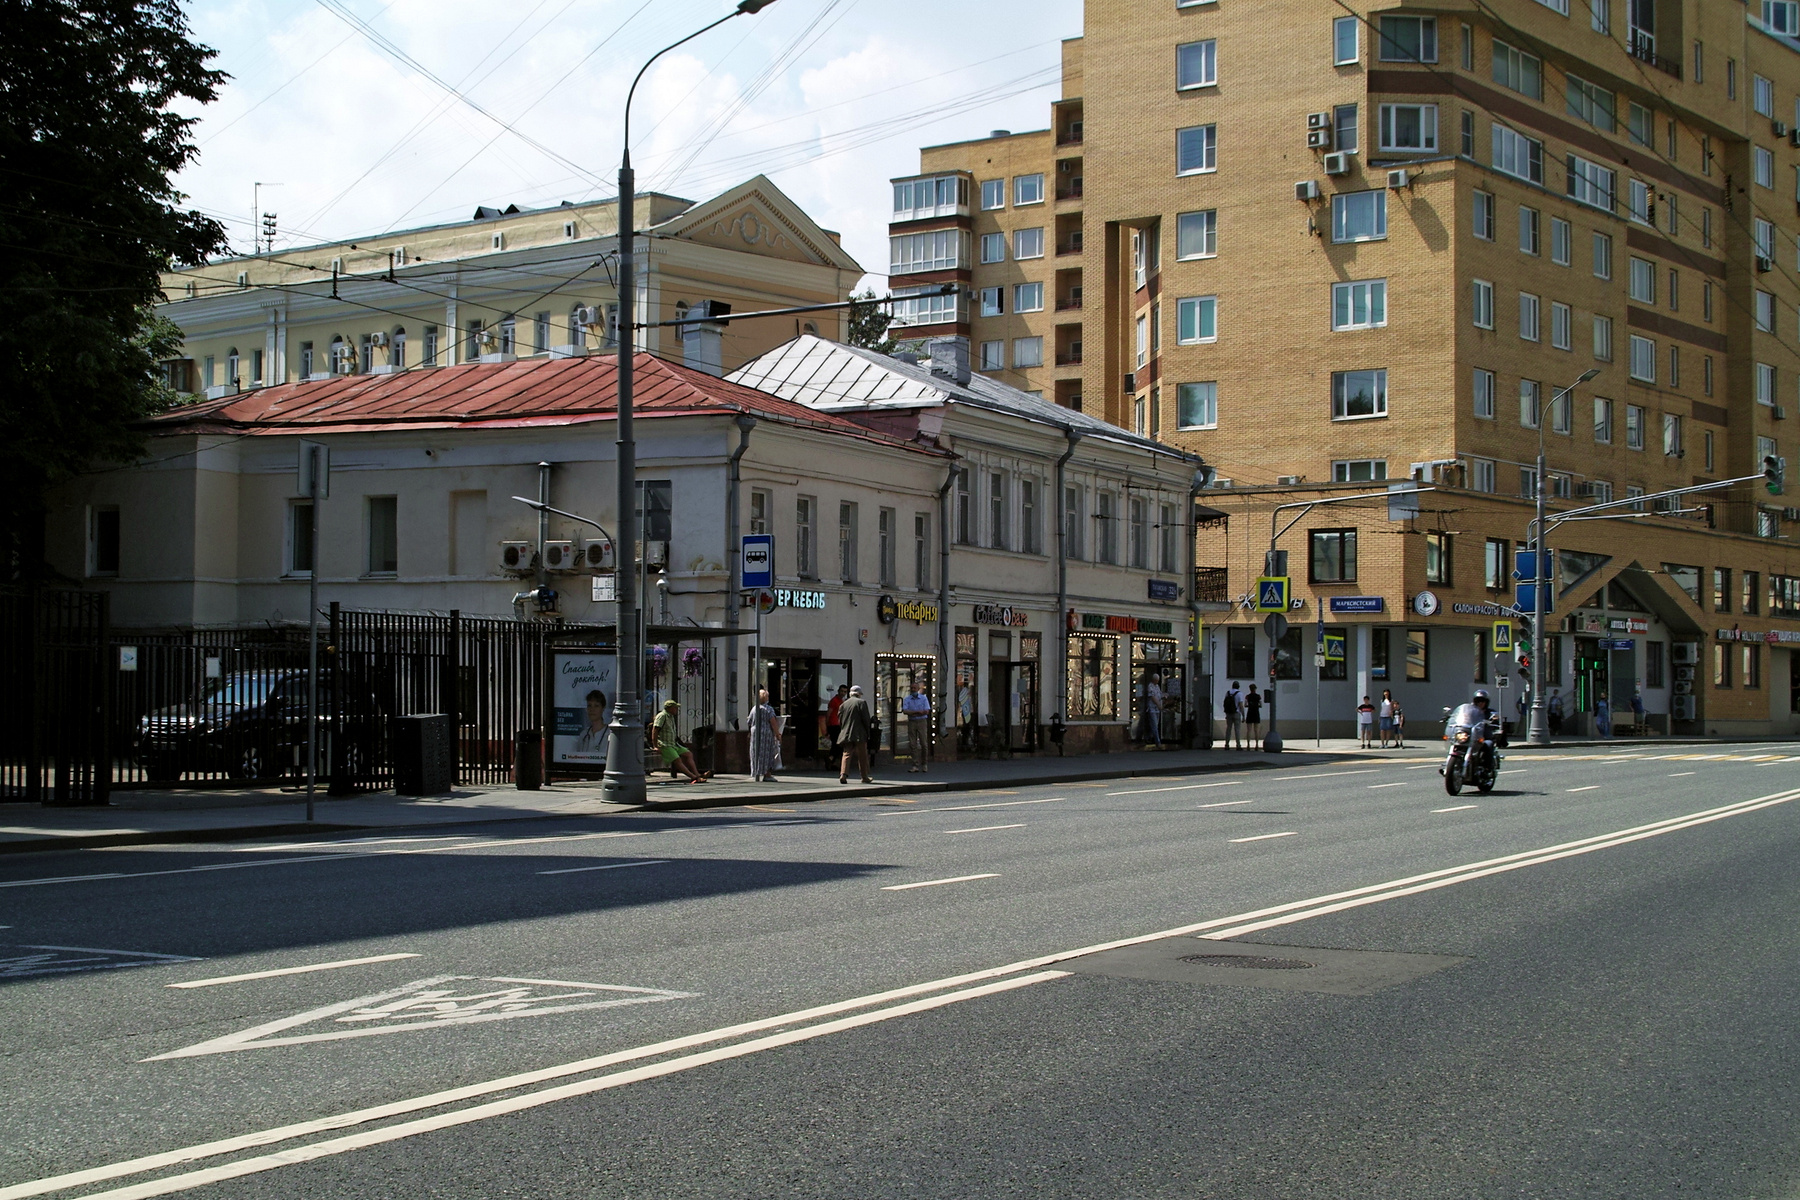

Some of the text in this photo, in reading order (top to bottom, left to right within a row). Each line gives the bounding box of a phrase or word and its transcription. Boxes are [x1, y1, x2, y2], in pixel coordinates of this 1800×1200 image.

[897, 600, 938, 626] пекарня
[976, 601, 1003, 626] Coffee
[1454, 603, 1473, 613] САЛОН
[1474, 604, 1500, 616] КРАСОТЫ
[1085, 613, 1105, 629] КАФЕ
[1109, 615, 1138, 632] ПИЦЦА
[1140, 619, 1172, 634] СТОЛОВАЯ
[1718, 628, 1735, 640] ОПТИКА
[562, 660, 595, 675] Спасибо,
[571, 669, 610, 689] доктор!
